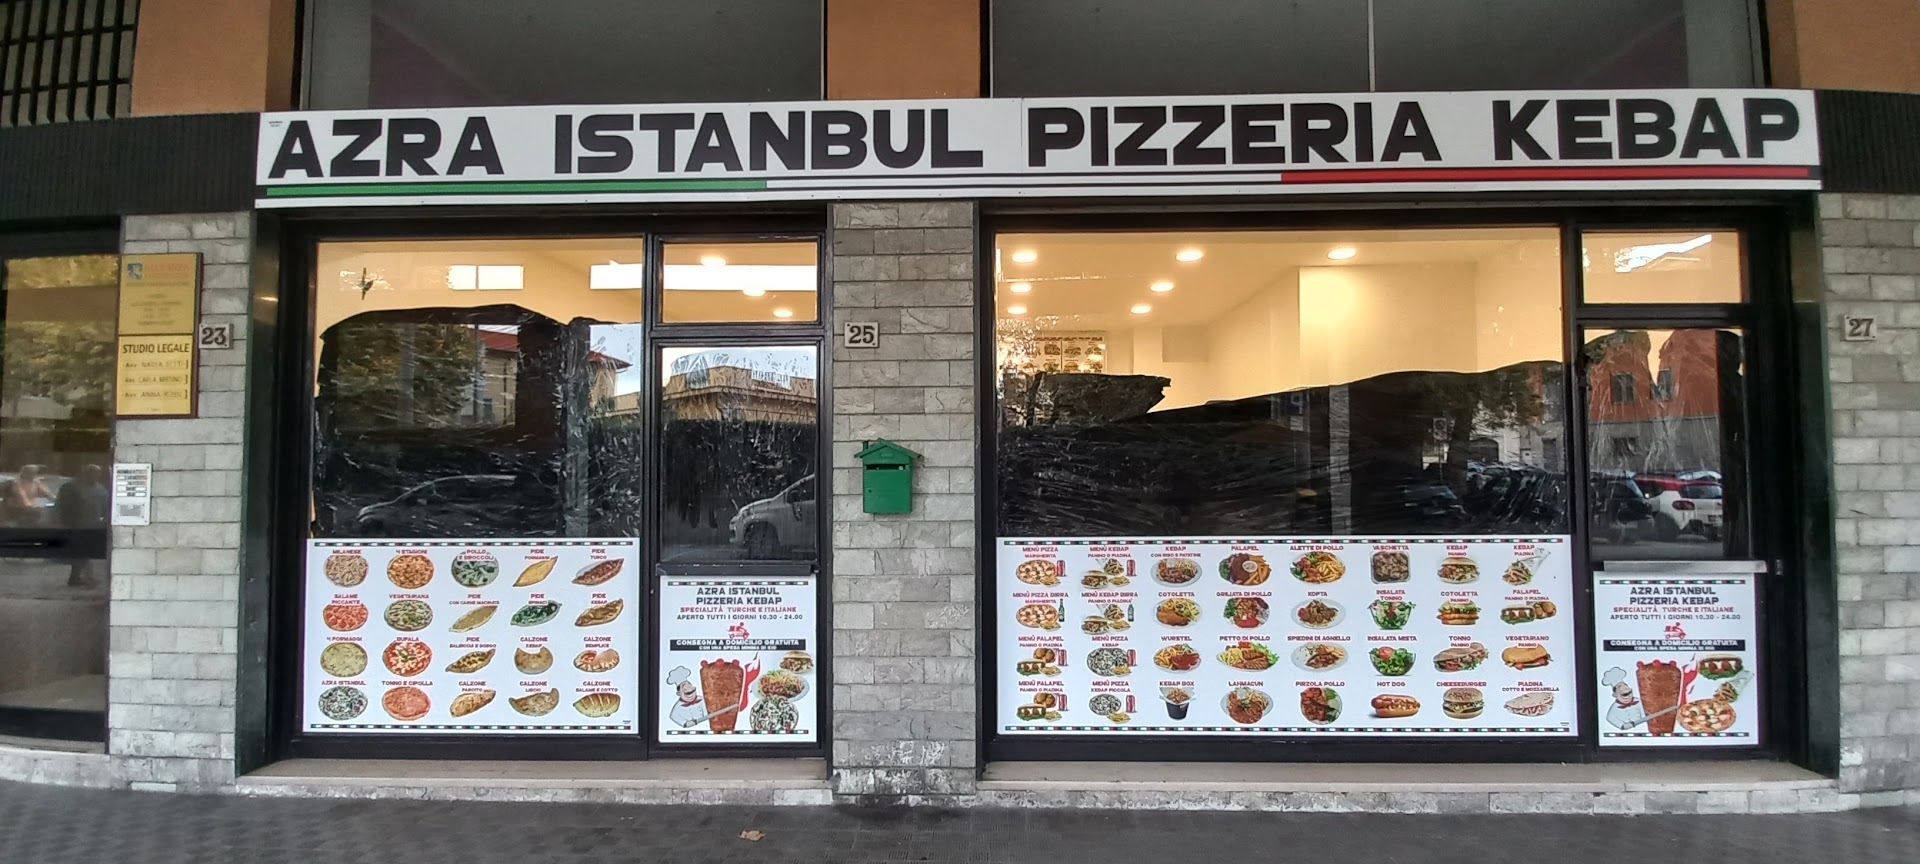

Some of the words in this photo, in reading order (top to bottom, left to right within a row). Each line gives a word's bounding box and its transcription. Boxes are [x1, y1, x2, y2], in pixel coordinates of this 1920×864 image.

[268, 116, 504, 178] AZRA
[554, 108, 984, 173] ISTANBUL
[1028, 101, 1442, 167] PIZZERIA
[1494, 97, 1801, 162] KEBAP
[201, 327, 226, 345] 23
[849, 325, 875, 344] 25
[1849, 318, 1873, 336] 27
[122, 344, 155, 353] STUDIO
[157, 343, 190, 353] LEGALE
[697, 587, 725, 595] AZRA
[729, 587, 779, 595] ISTANBUL
[1630, 597, 1679, 605] PIZZERIA
[1682, 597, 1719, 605] KEBAP
